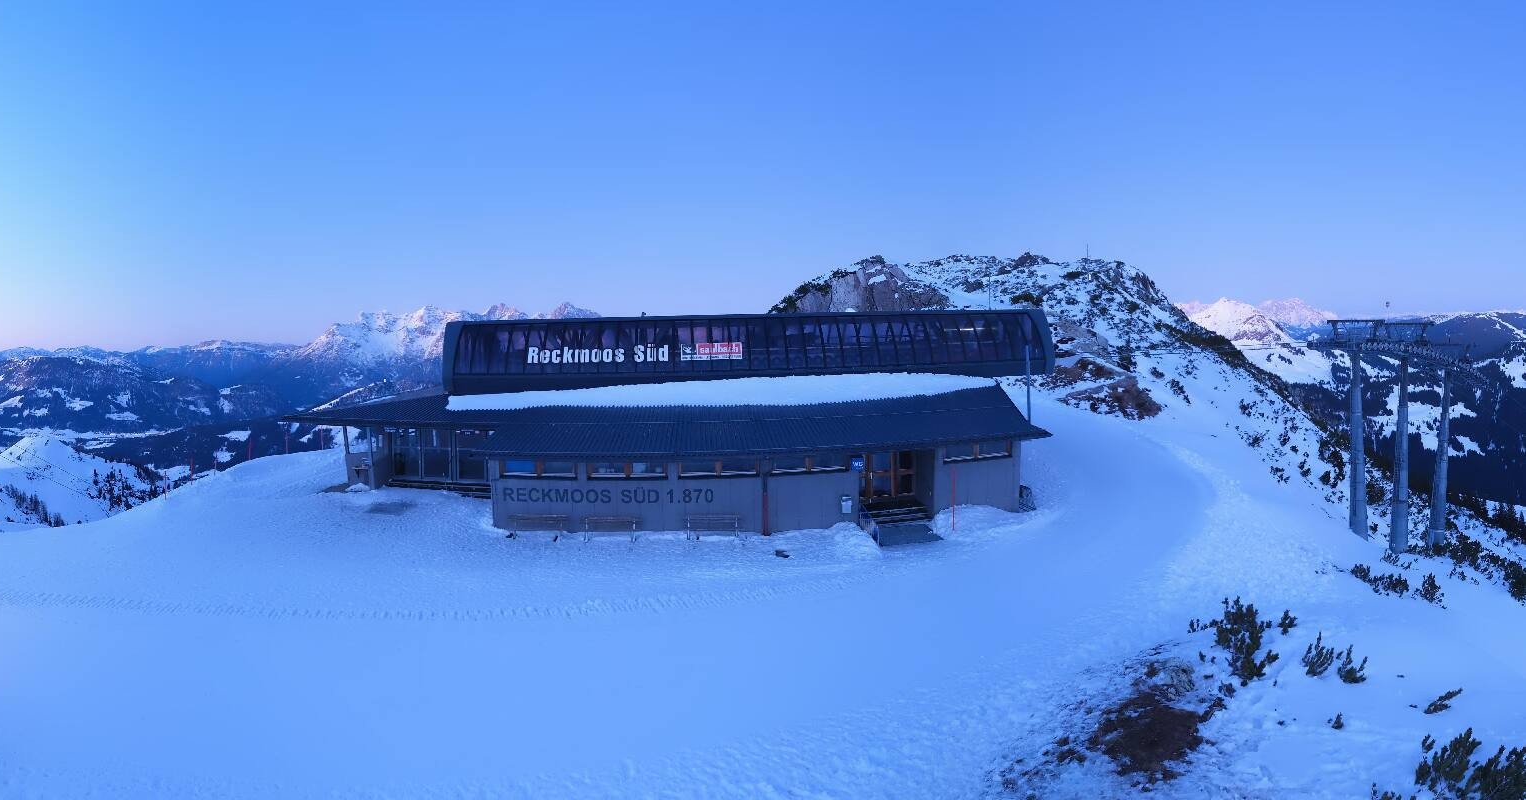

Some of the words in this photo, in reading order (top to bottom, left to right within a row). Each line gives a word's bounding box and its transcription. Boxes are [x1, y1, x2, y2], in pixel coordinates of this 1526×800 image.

[527, 346, 625, 364] Reckmoos
[633, 343, 669, 363] Süd
[502, 487, 612, 503] RECKMOOS
[621, 486, 660, 504] SÜD
[666, 488, 714, 504] 1.870
